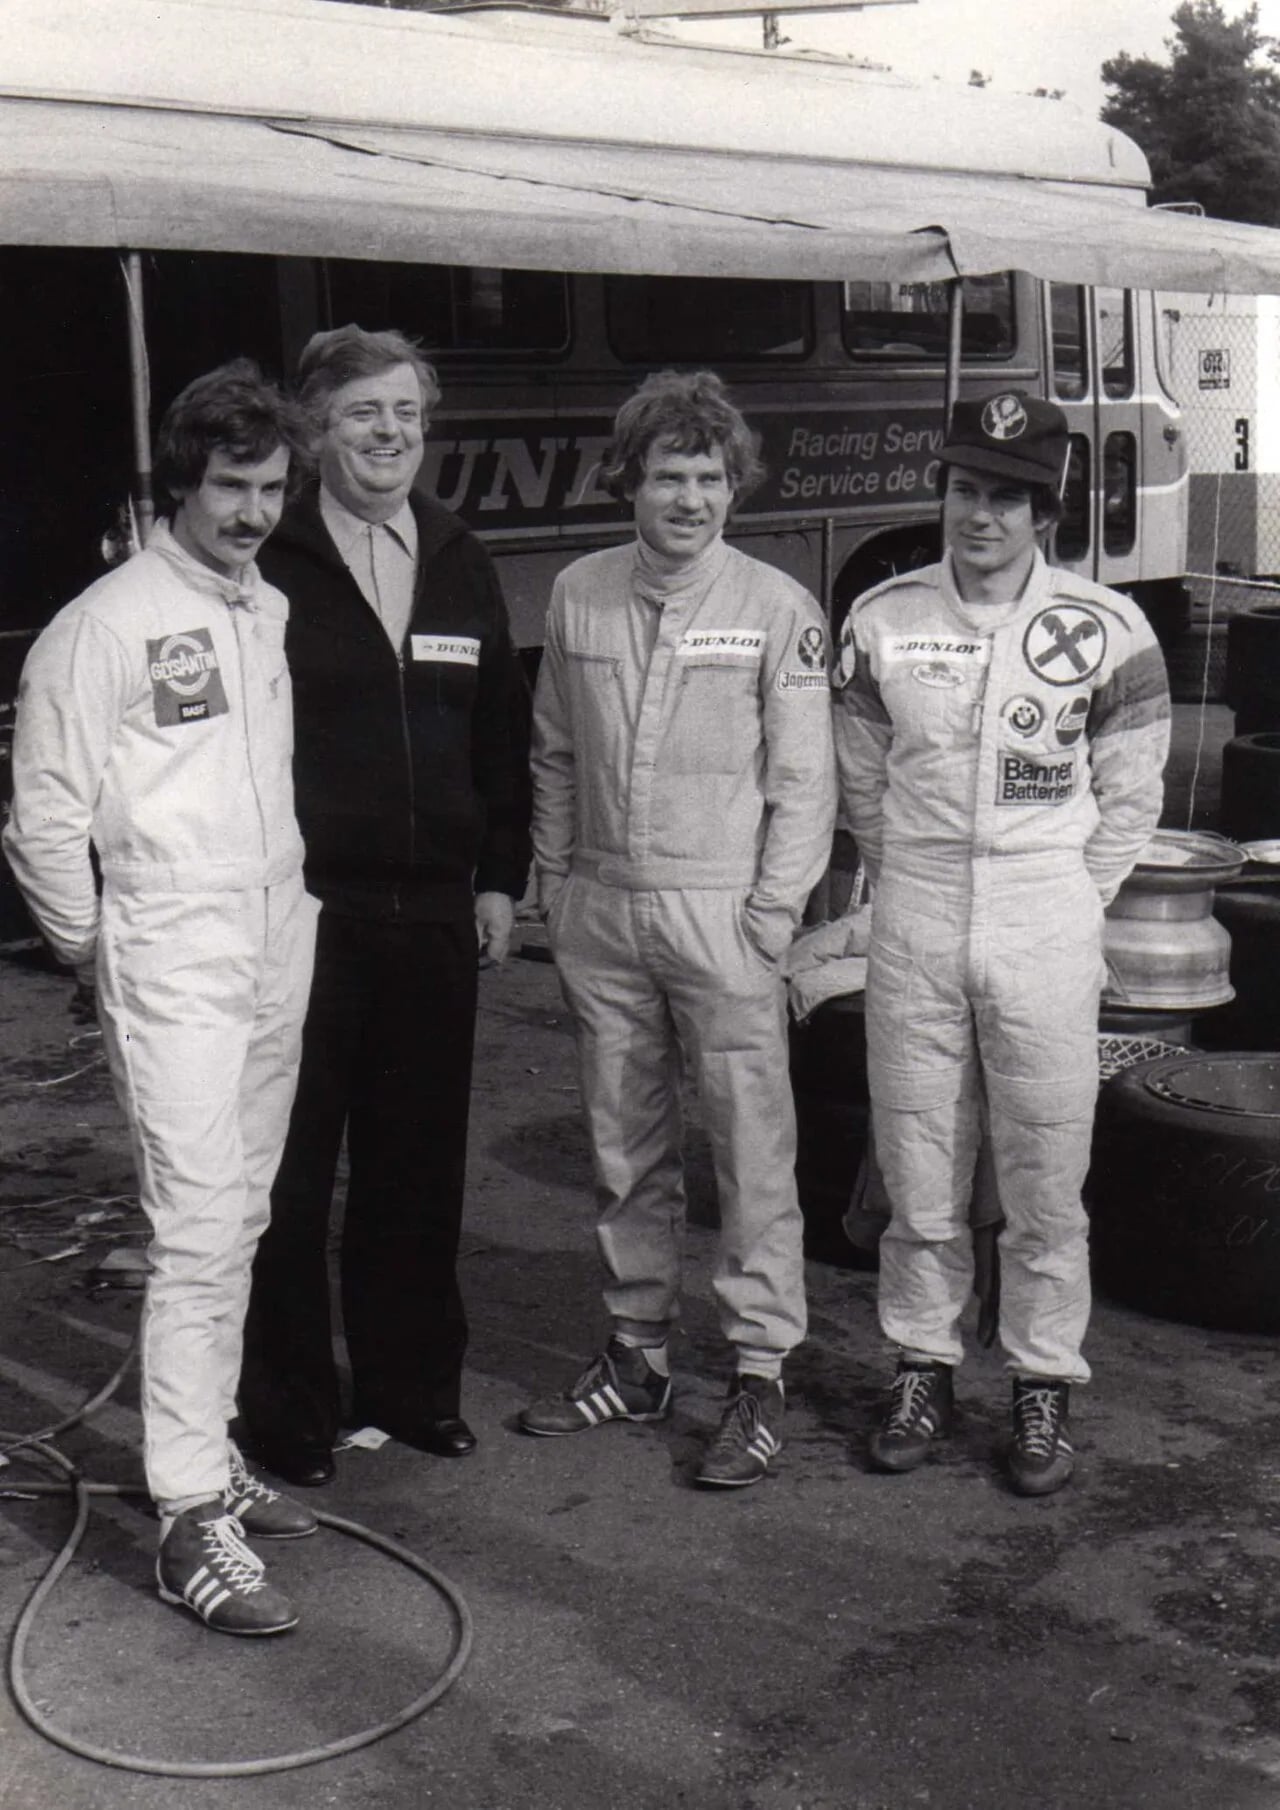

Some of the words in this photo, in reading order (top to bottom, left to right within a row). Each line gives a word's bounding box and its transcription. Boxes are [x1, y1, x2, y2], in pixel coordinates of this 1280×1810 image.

[788, 425, 878, 461] Racing
[1234, 417, 1249, 471] 3
[779, 464, 880, 499] Service
[885, 463, 917, 492] de
[906, 641, 982, 655] DUNLOP
[181, 703, 208, 718] BASF
[1004, 757, 1073, 782] Banner
[1002, 782, 1073, 802] Batterien
